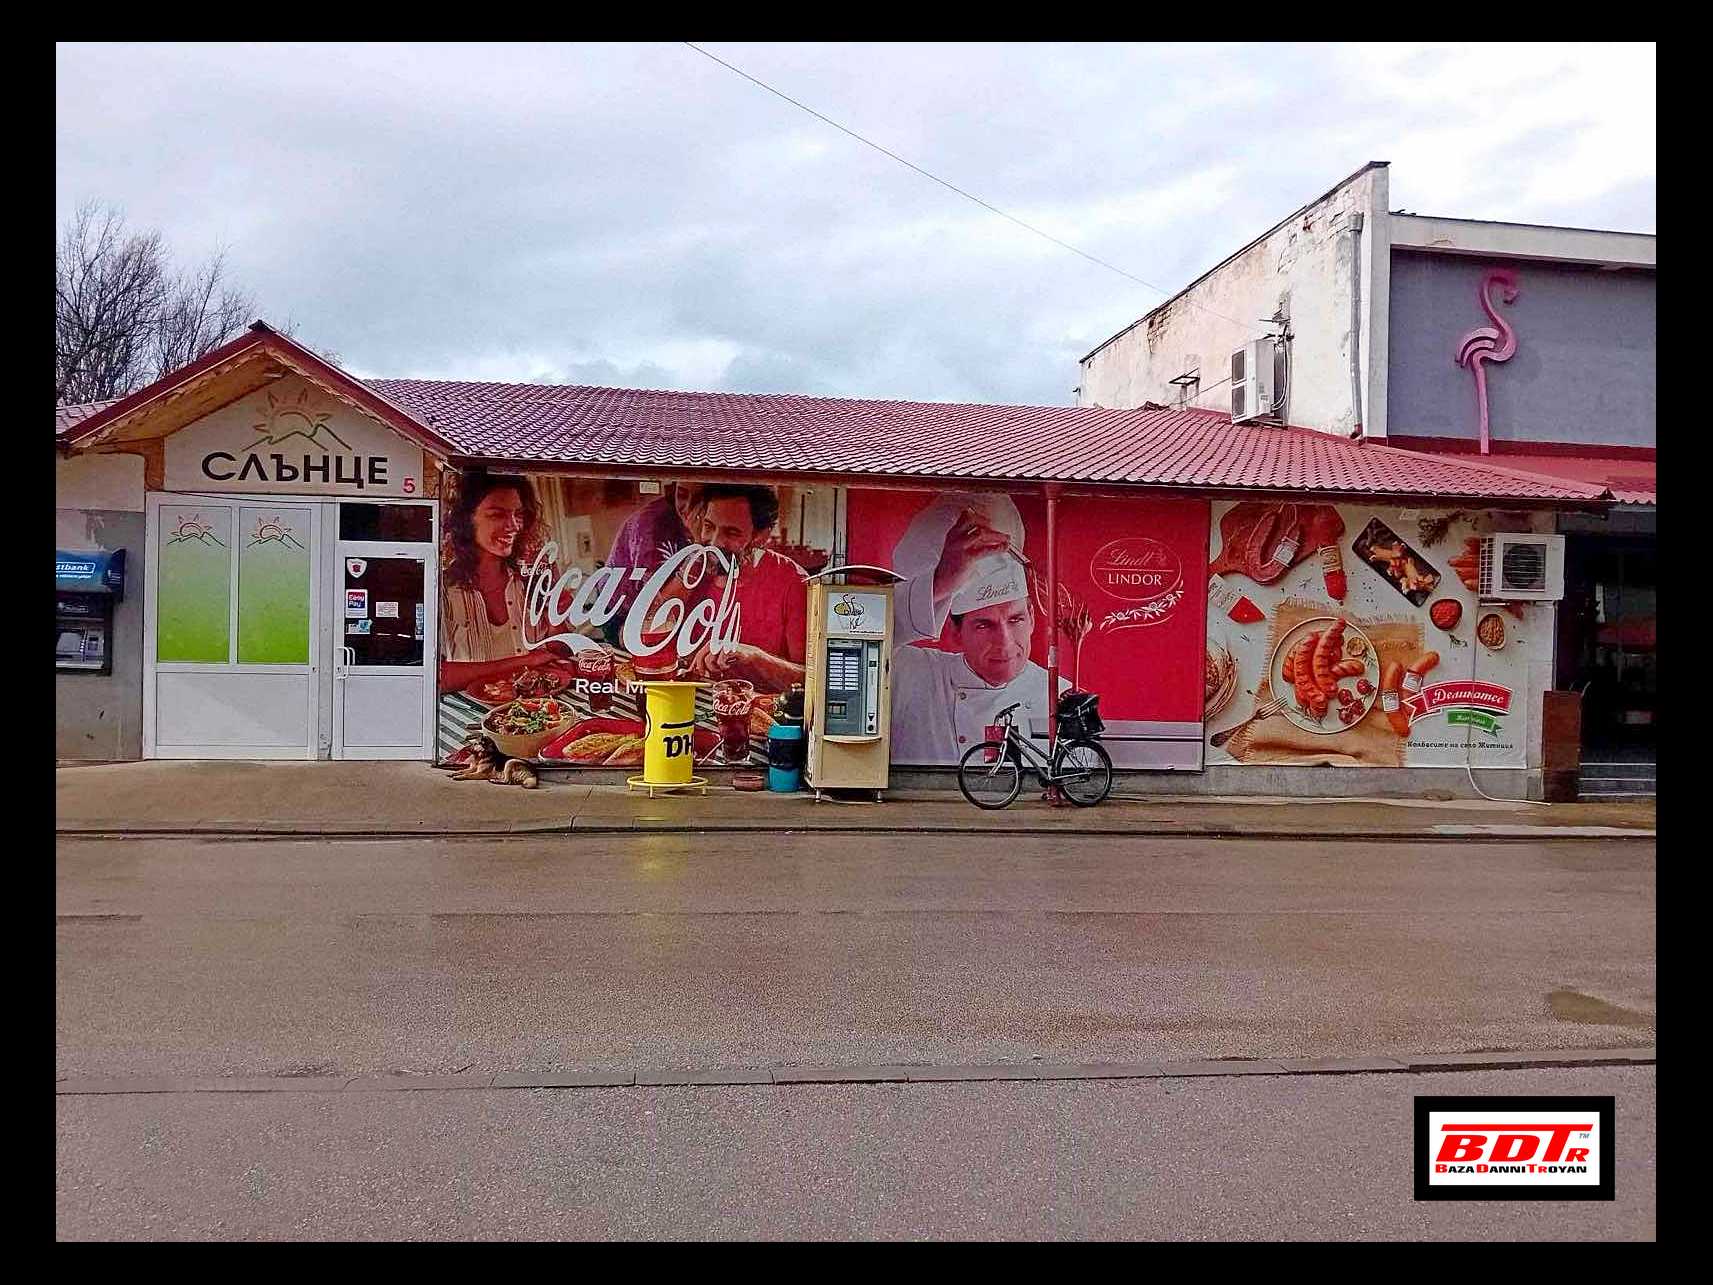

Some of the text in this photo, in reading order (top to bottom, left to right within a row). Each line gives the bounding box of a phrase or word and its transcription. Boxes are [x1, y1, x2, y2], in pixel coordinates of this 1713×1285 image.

[201, 451, 389, 489] СЛЪНЦЕ
[402, 477, 416, 493] 5
[1108, 573, 1162, 585] LINDOR
[575, 678, 620, 694] Real
[1432, 688, 1504, 704] Деликатес
